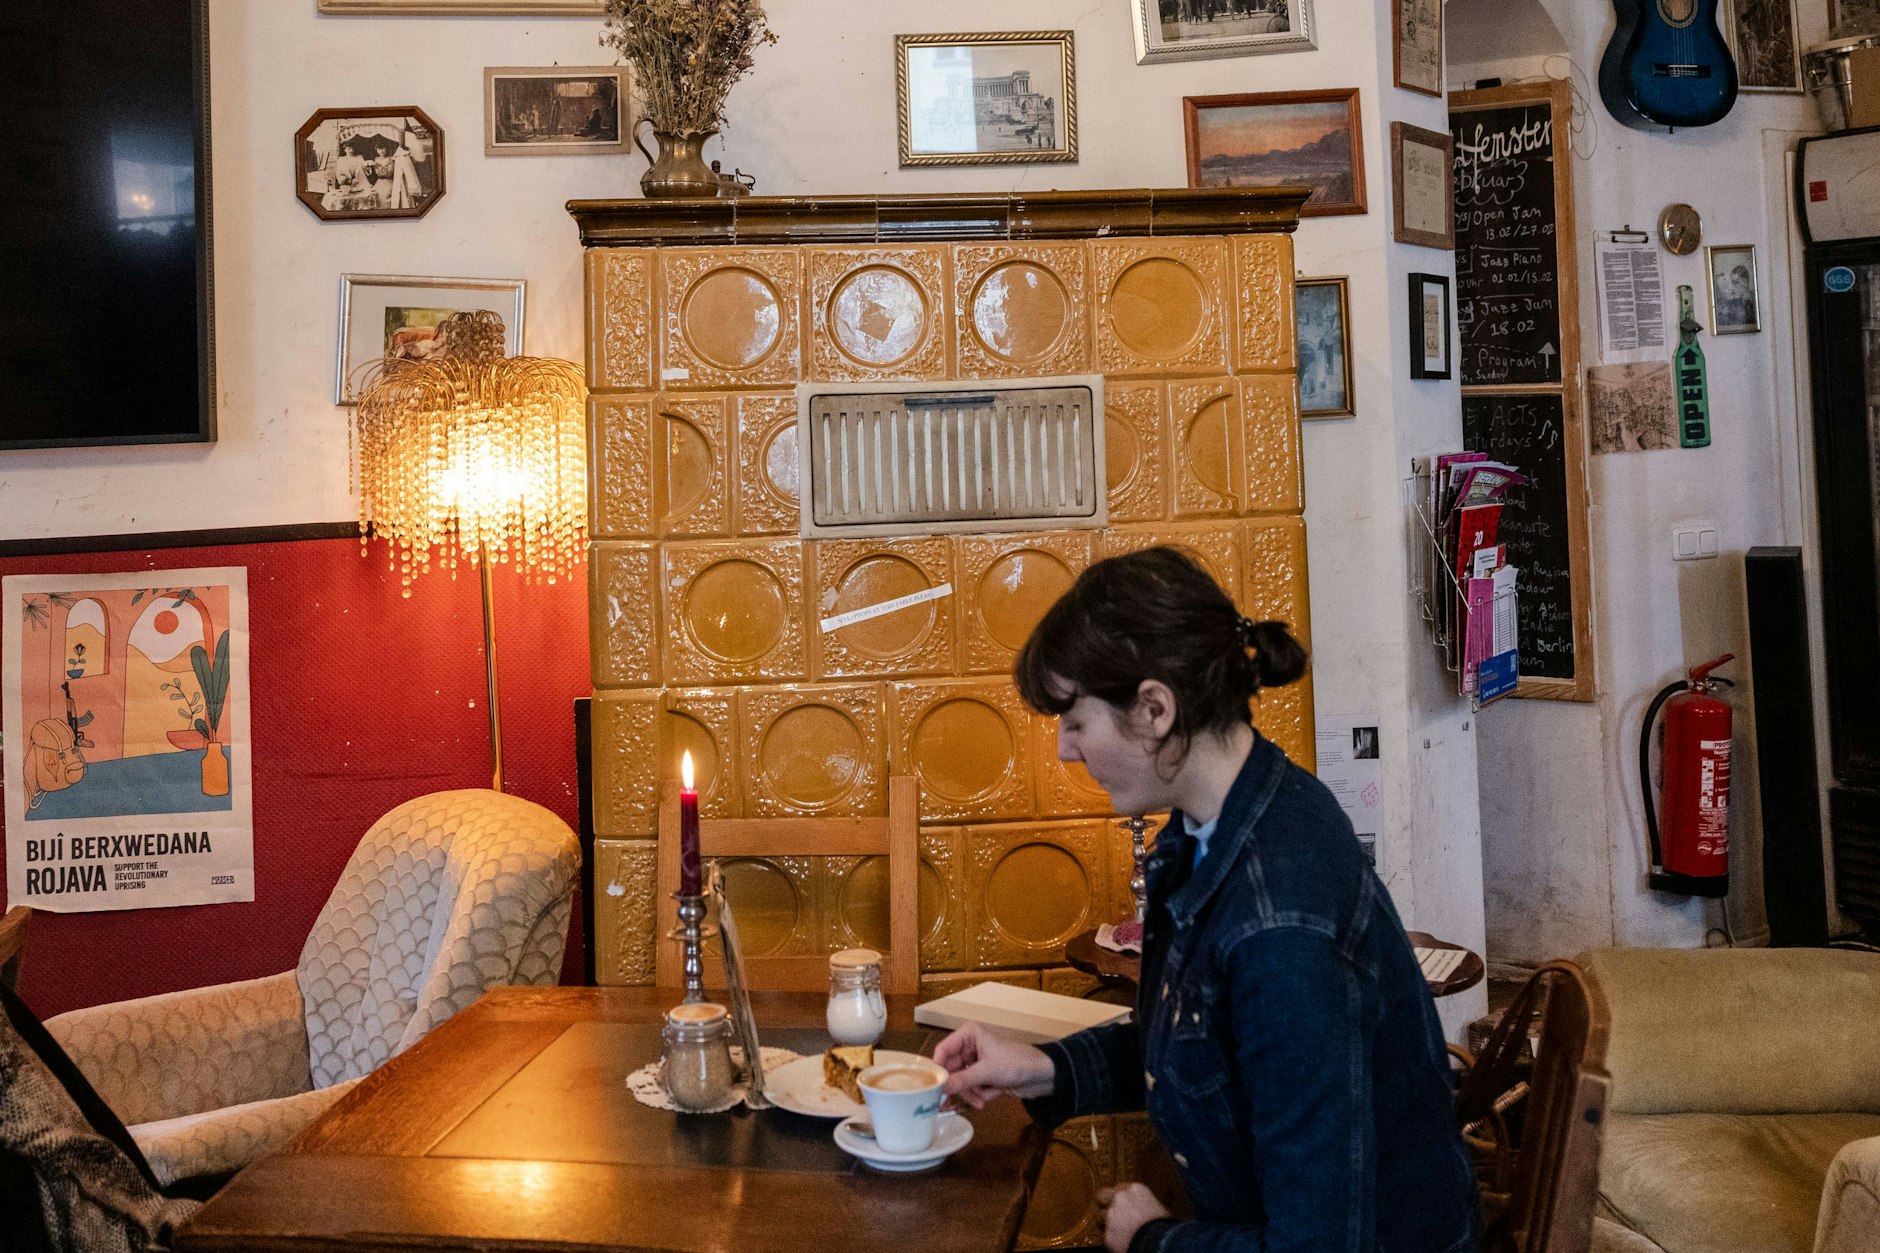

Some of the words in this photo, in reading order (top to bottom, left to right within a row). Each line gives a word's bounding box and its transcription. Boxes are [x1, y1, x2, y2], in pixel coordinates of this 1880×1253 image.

[1473, 210, 1504, 227] Open
[1512, 205, 1542, 220] Jam
[1513, 252, 1542, 267] Piano
[1480, 301, 1519, 316] Jazz
[1524, 298, 1553, 312] Jam
[1489, 320, 1536, 337] 18.02
[1478, 348, 1537, 374] Program
[1681, 368, 1705, 440] OPEN
[1490, 403, 1538, 428] ACTS
[881, 603, 895, 613] THIS
[895, 597, 914, 609] TABLE
[1536, 635, 1573, 655] Berlin
[26, 832, 64, 862] BIJÎ
[71, 831, 213, 860] BERXWEDANA
[114, 862, 145, 873] SUPPORT
[145, 861, 159, 871] THE
[114, 870, 169, 881] REVOLUTIONARY
[26, 865, 108, 896] ROJAVA
[114, 880, 146, 891] UPRISING
